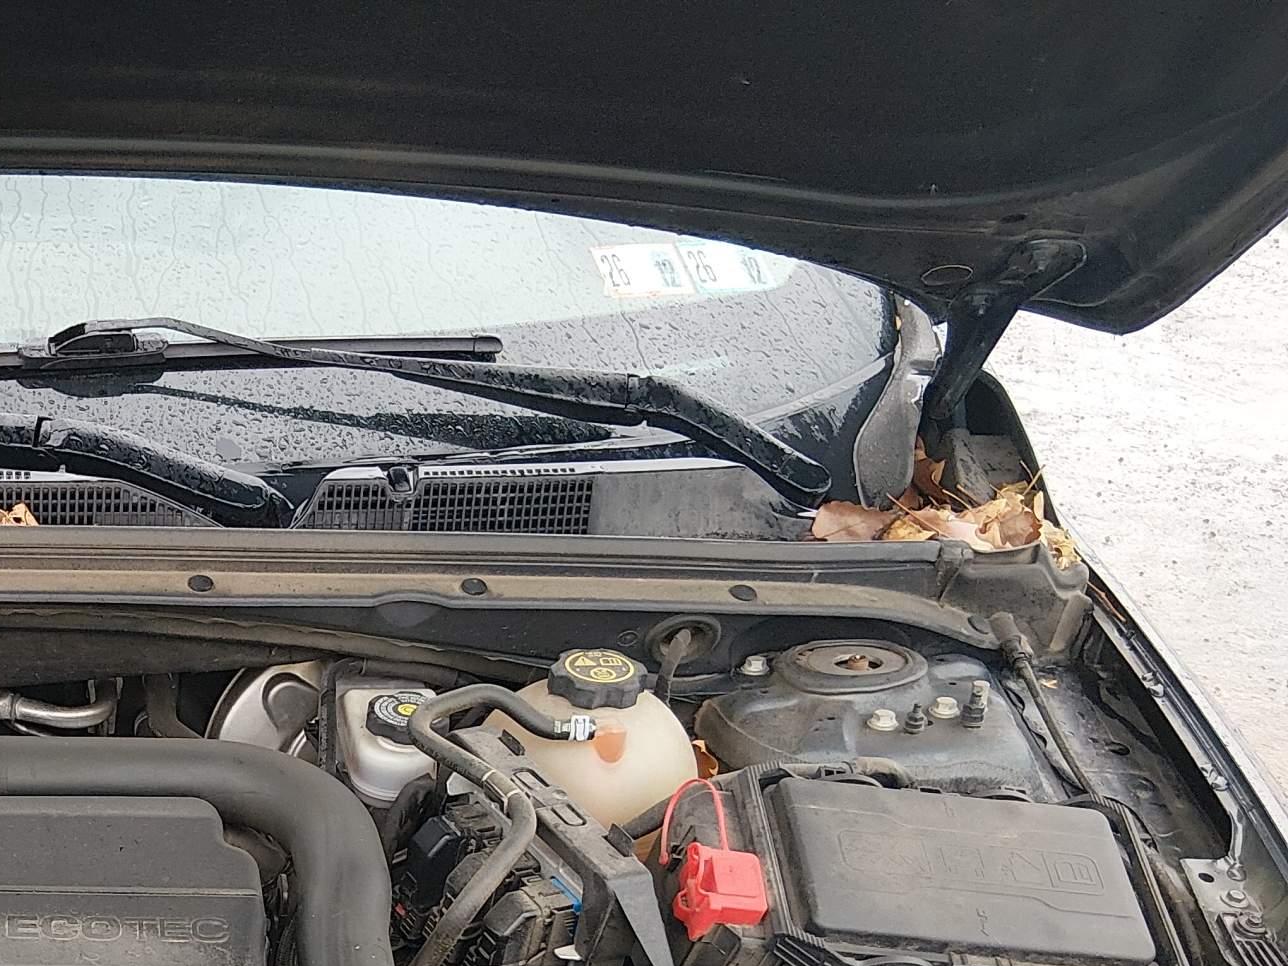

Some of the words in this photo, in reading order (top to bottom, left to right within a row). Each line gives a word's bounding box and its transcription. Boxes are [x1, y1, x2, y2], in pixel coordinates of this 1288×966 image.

[599, 253, 632, 287] 26
[687, 249, 718, 283] 26
[741, 256, 768, 285] 12
[5, 913, 231, 943] ECOTEC
